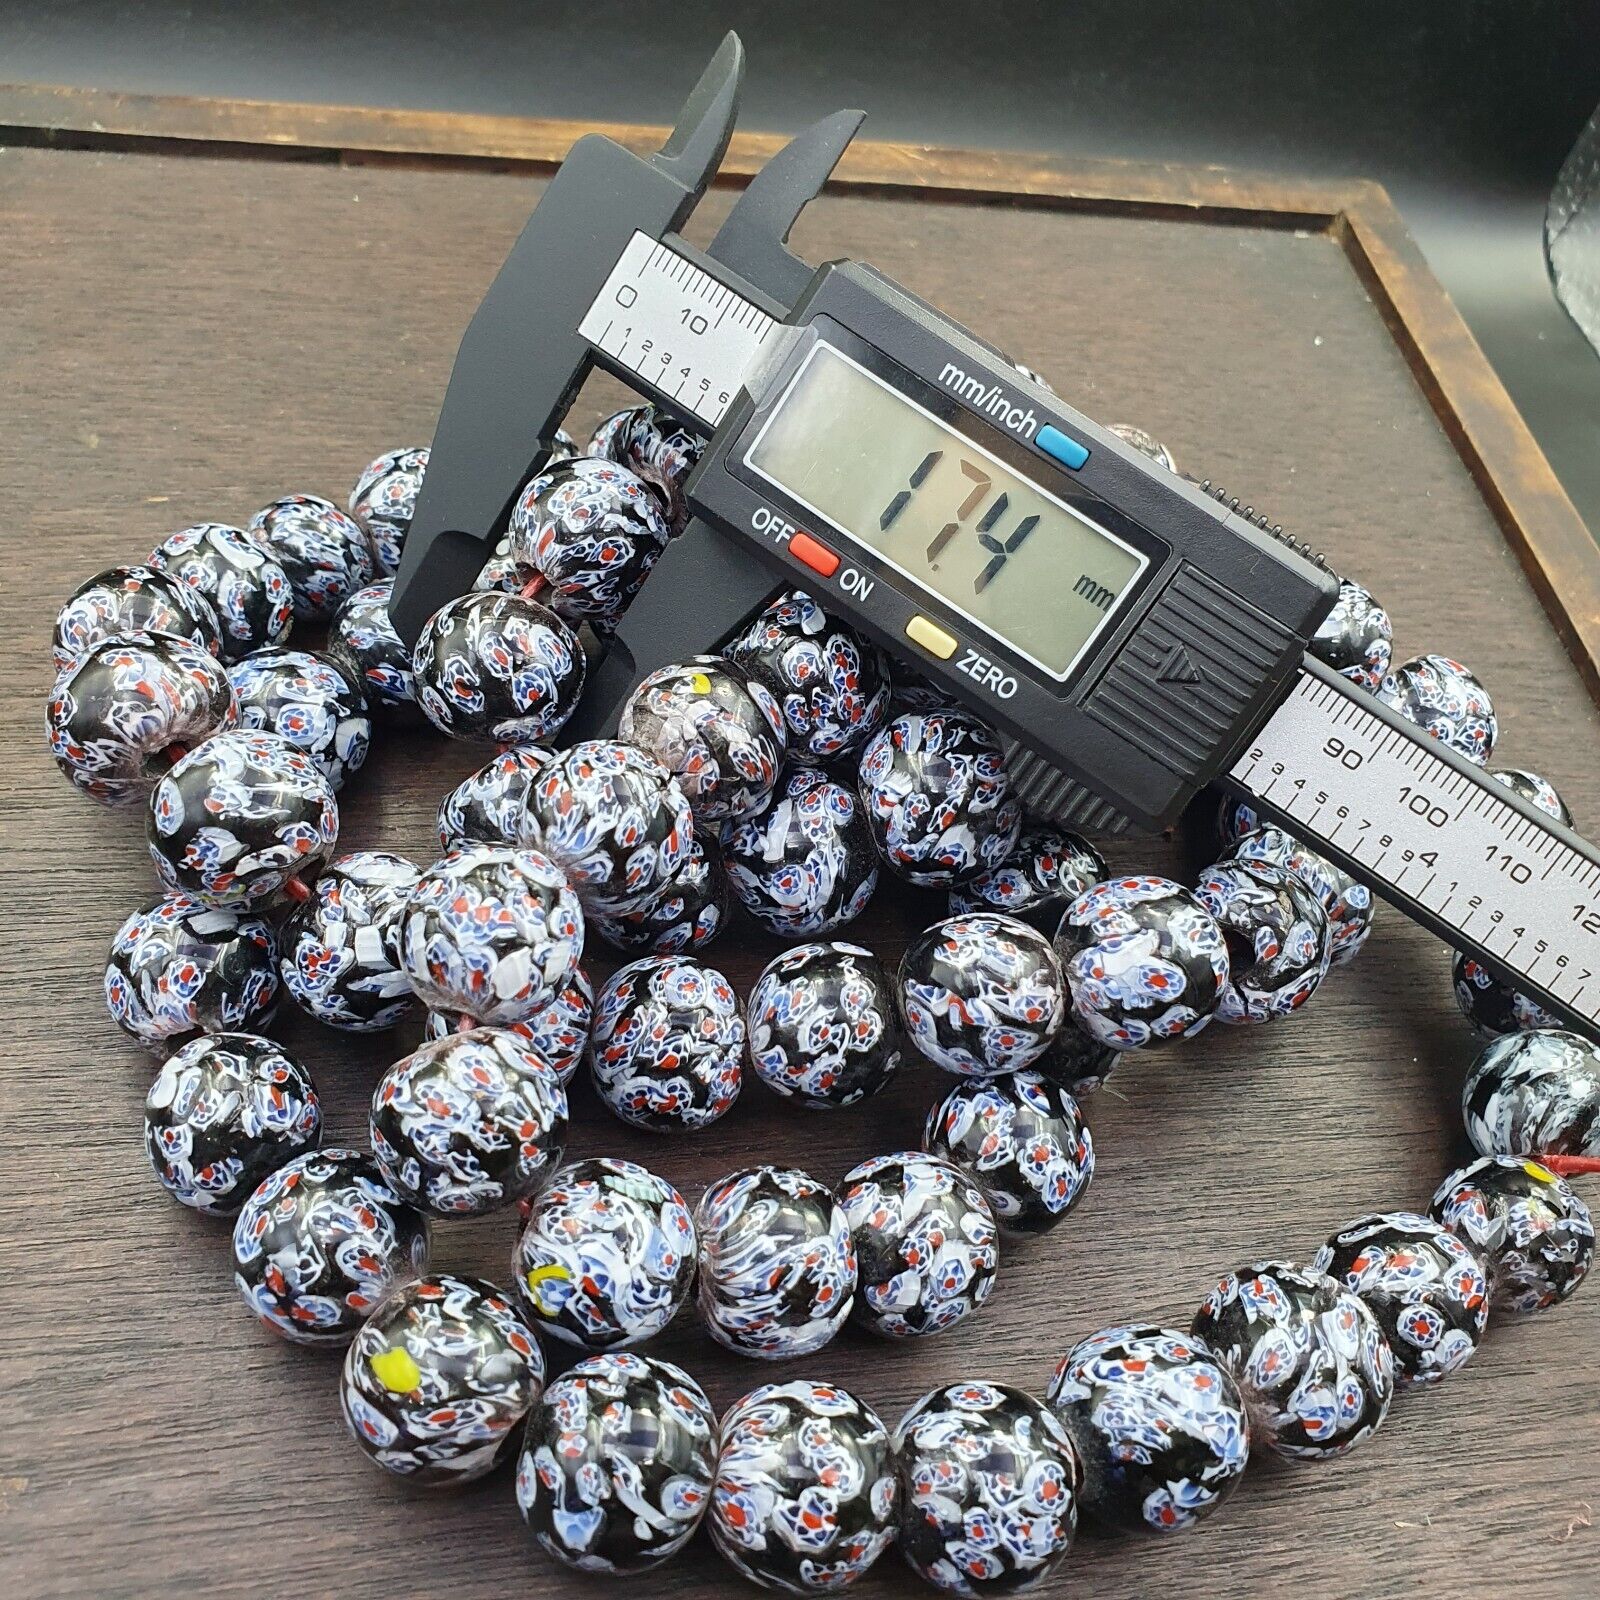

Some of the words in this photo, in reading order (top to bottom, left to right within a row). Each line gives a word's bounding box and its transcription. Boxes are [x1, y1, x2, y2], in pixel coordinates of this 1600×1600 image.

[615, 284, 638, 308] 0
[681, 308, 708, 335] 10
[624, 327, 632, 337] 1
[641, 339, 653, 352] 2
[660, 352, 672, 365] 3
[680, 367, 691, 378] 4
[699, 378, 711, 391] 5
[718, 391, 730, 404] 6
[938, 361, 1038, 439] mm/inch
[751, 507, 796, 545] OFF
[838, 568, 875, 602] ON
[1072, 573, 1116, 613] mm
[955, 648, 1019, 700] ZERO
[1323, 737, 1363, 770] 90
[1399, 786, 1449, 828] 100
[1486, 845, 1532, 884] 110
[1249, 748, 1263, 761] 2
[1271, 762, 1285, 775] 3
[1294, 779, 1306, 789] 4
[1315, 791, 1329, 804] 5
[1336, 806, 1349, 819] 6
[1358, 819, 1372, 830] 7
[1379, 834, 1393, 847] 8
[1401, 850, 1415, 862] 9
[1419, 851, 1439, 868] 4
[1450, 881, 1458, 892] 1
[1467, 895, 1483, 909] 2
[1490, 910, 1504, 923] 3
[1512, 927, 1526, 938] 4
[1534, 939, 1549, 953] 5
[1556, 955, 1570, 968] 6
[1577, 968, 1592, 981] 7
